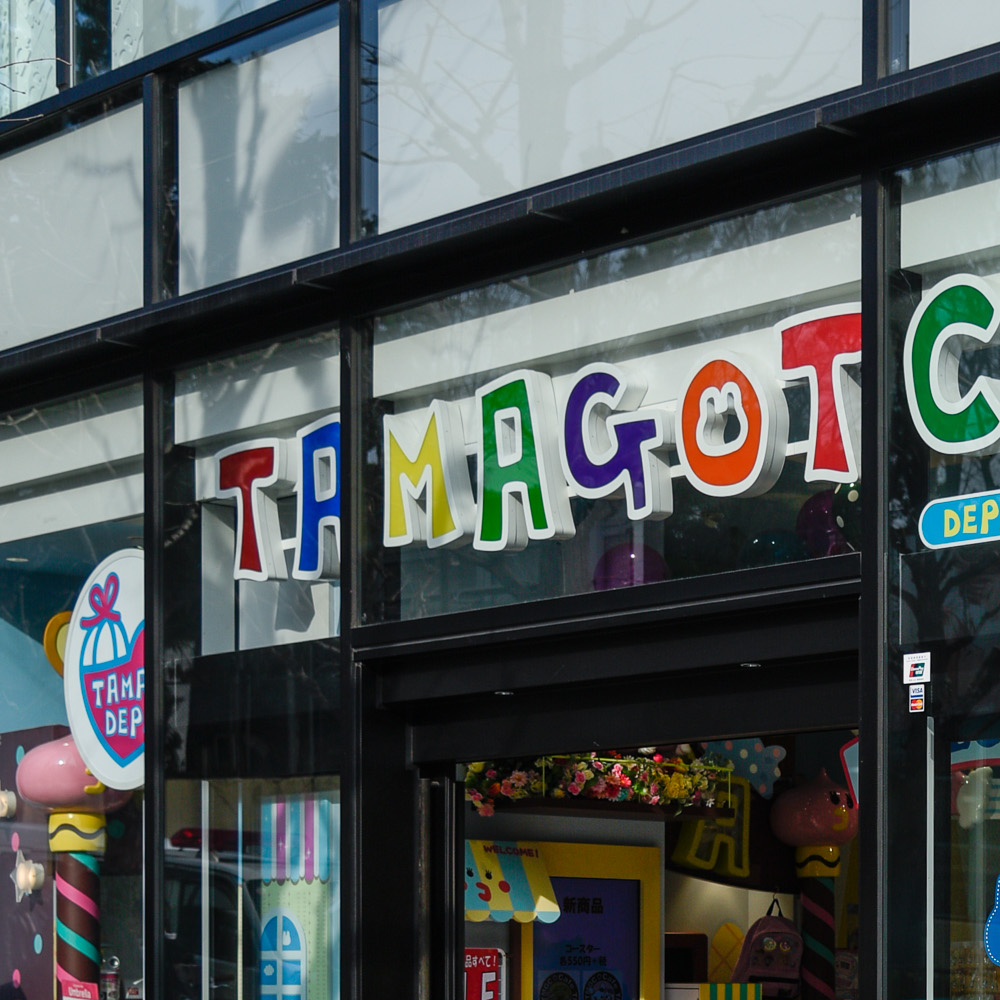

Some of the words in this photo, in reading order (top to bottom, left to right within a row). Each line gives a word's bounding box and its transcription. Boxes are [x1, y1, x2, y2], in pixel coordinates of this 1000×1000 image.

[483, 844, 539, 858] WELCOME!
[563, 896, 604, 914] 新商品
